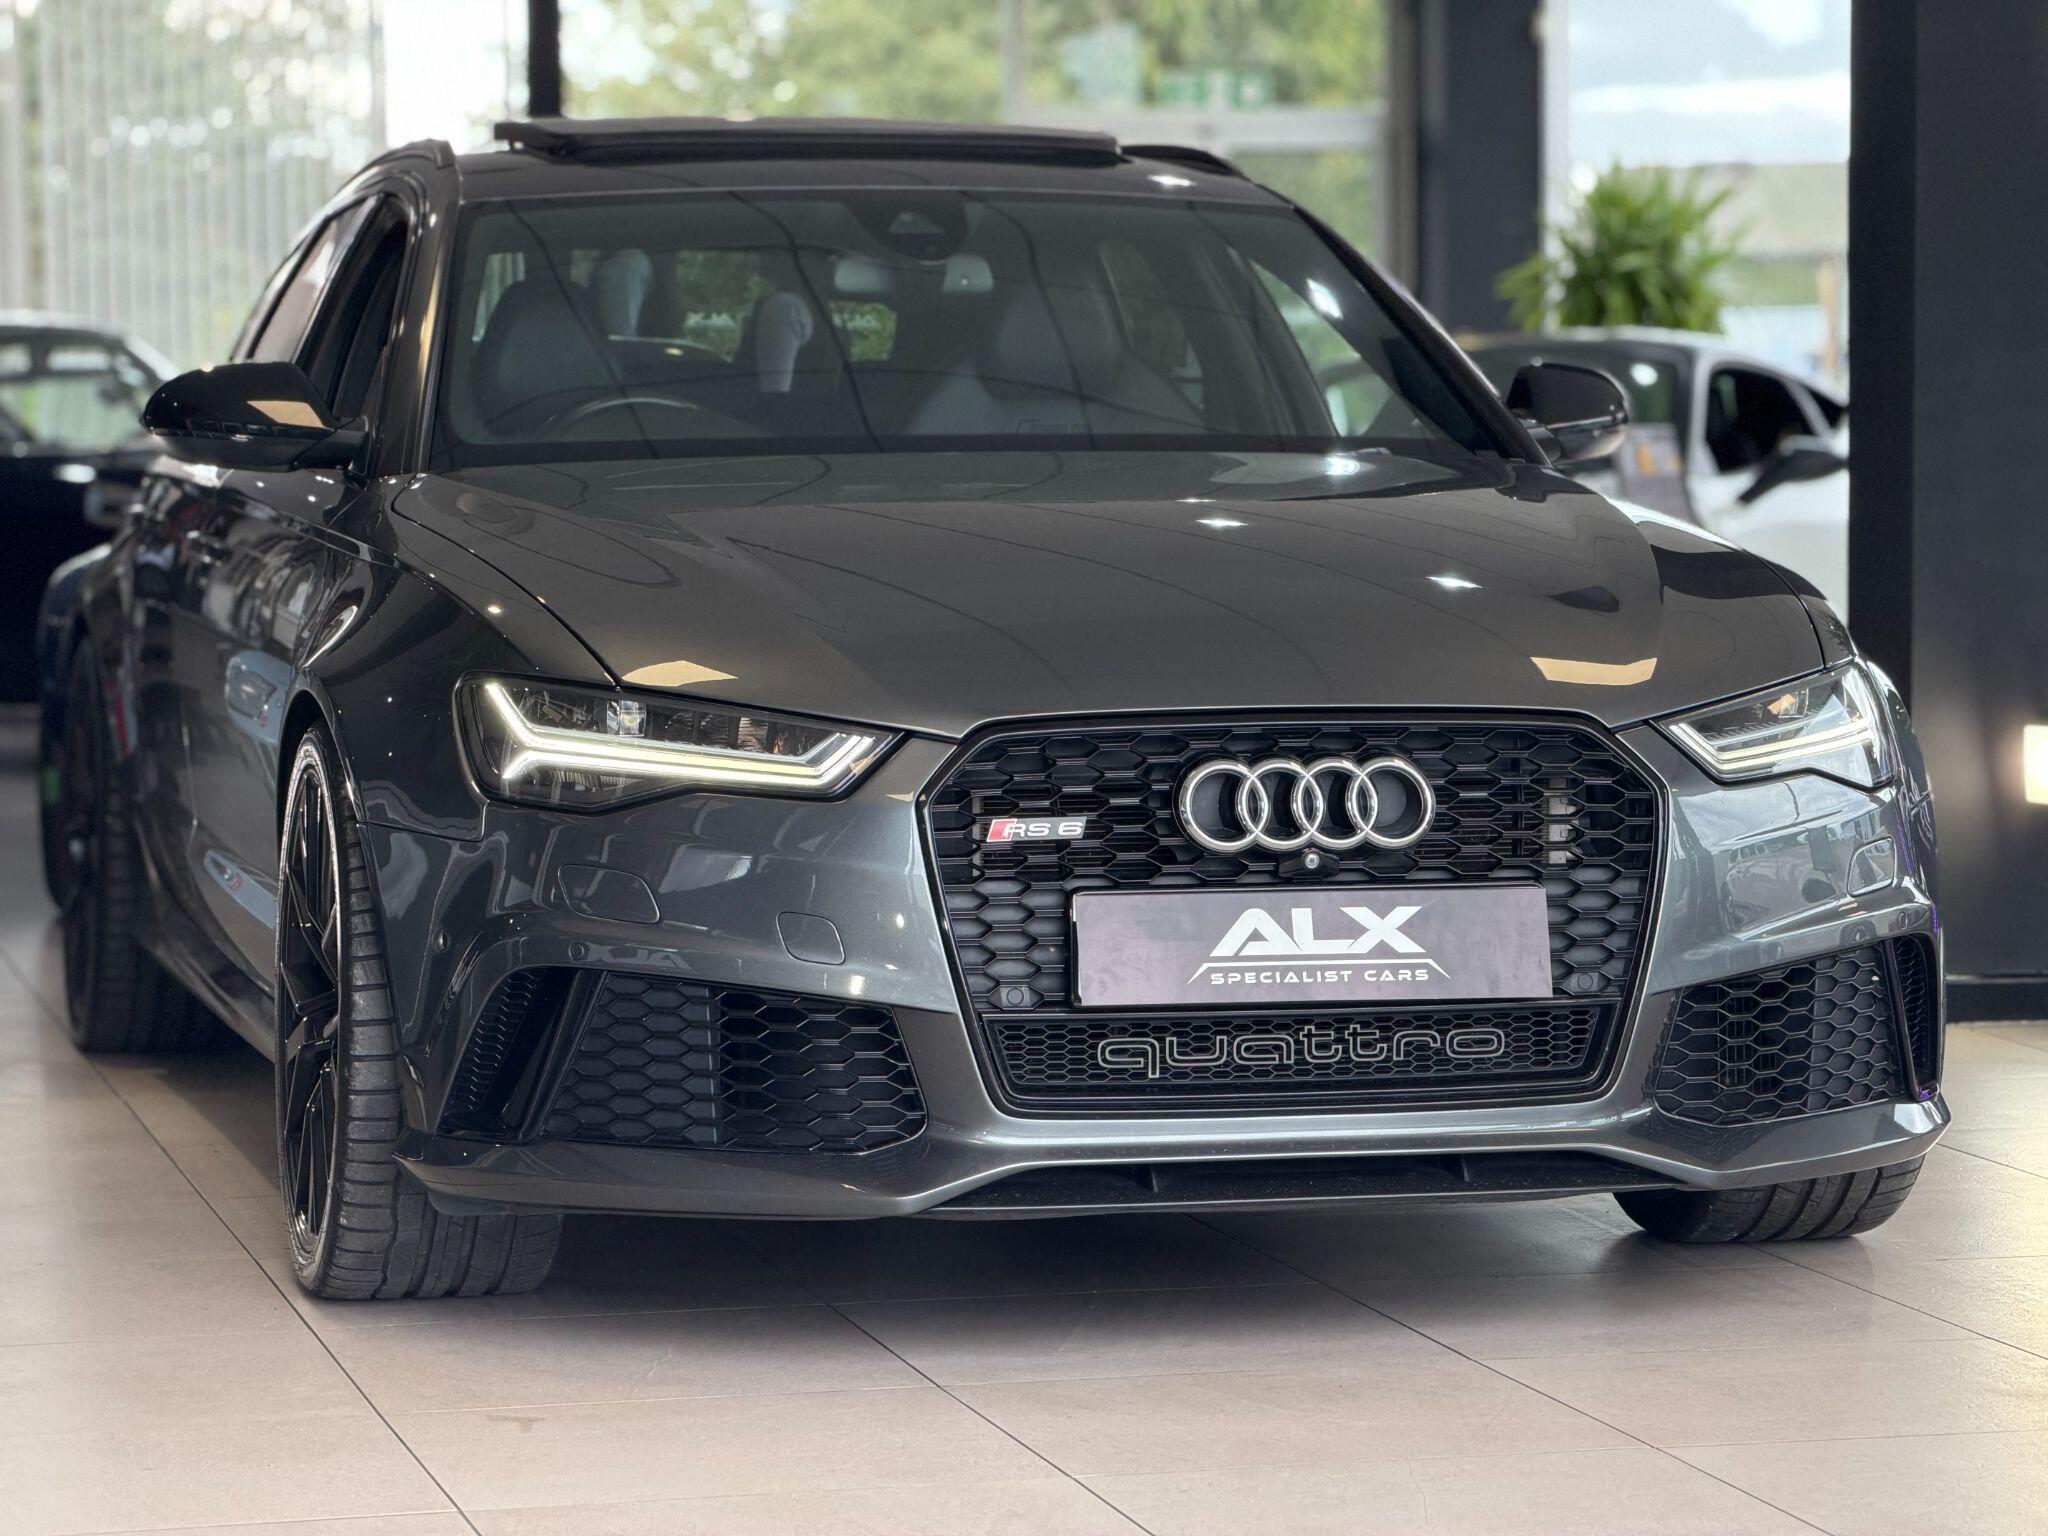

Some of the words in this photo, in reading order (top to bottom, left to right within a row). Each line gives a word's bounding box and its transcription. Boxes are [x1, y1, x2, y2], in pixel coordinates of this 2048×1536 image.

[1002, 822, 1051, 838] RS
[1057, 821, 1083, 836] 6
[1209, 905, 1427, 957] ALX
[1210, 970, 1353, 985] SPECIALIST
[1364, 969, 1429, 982] CARS
[1098, 1024, 1505, 1079] quattro
